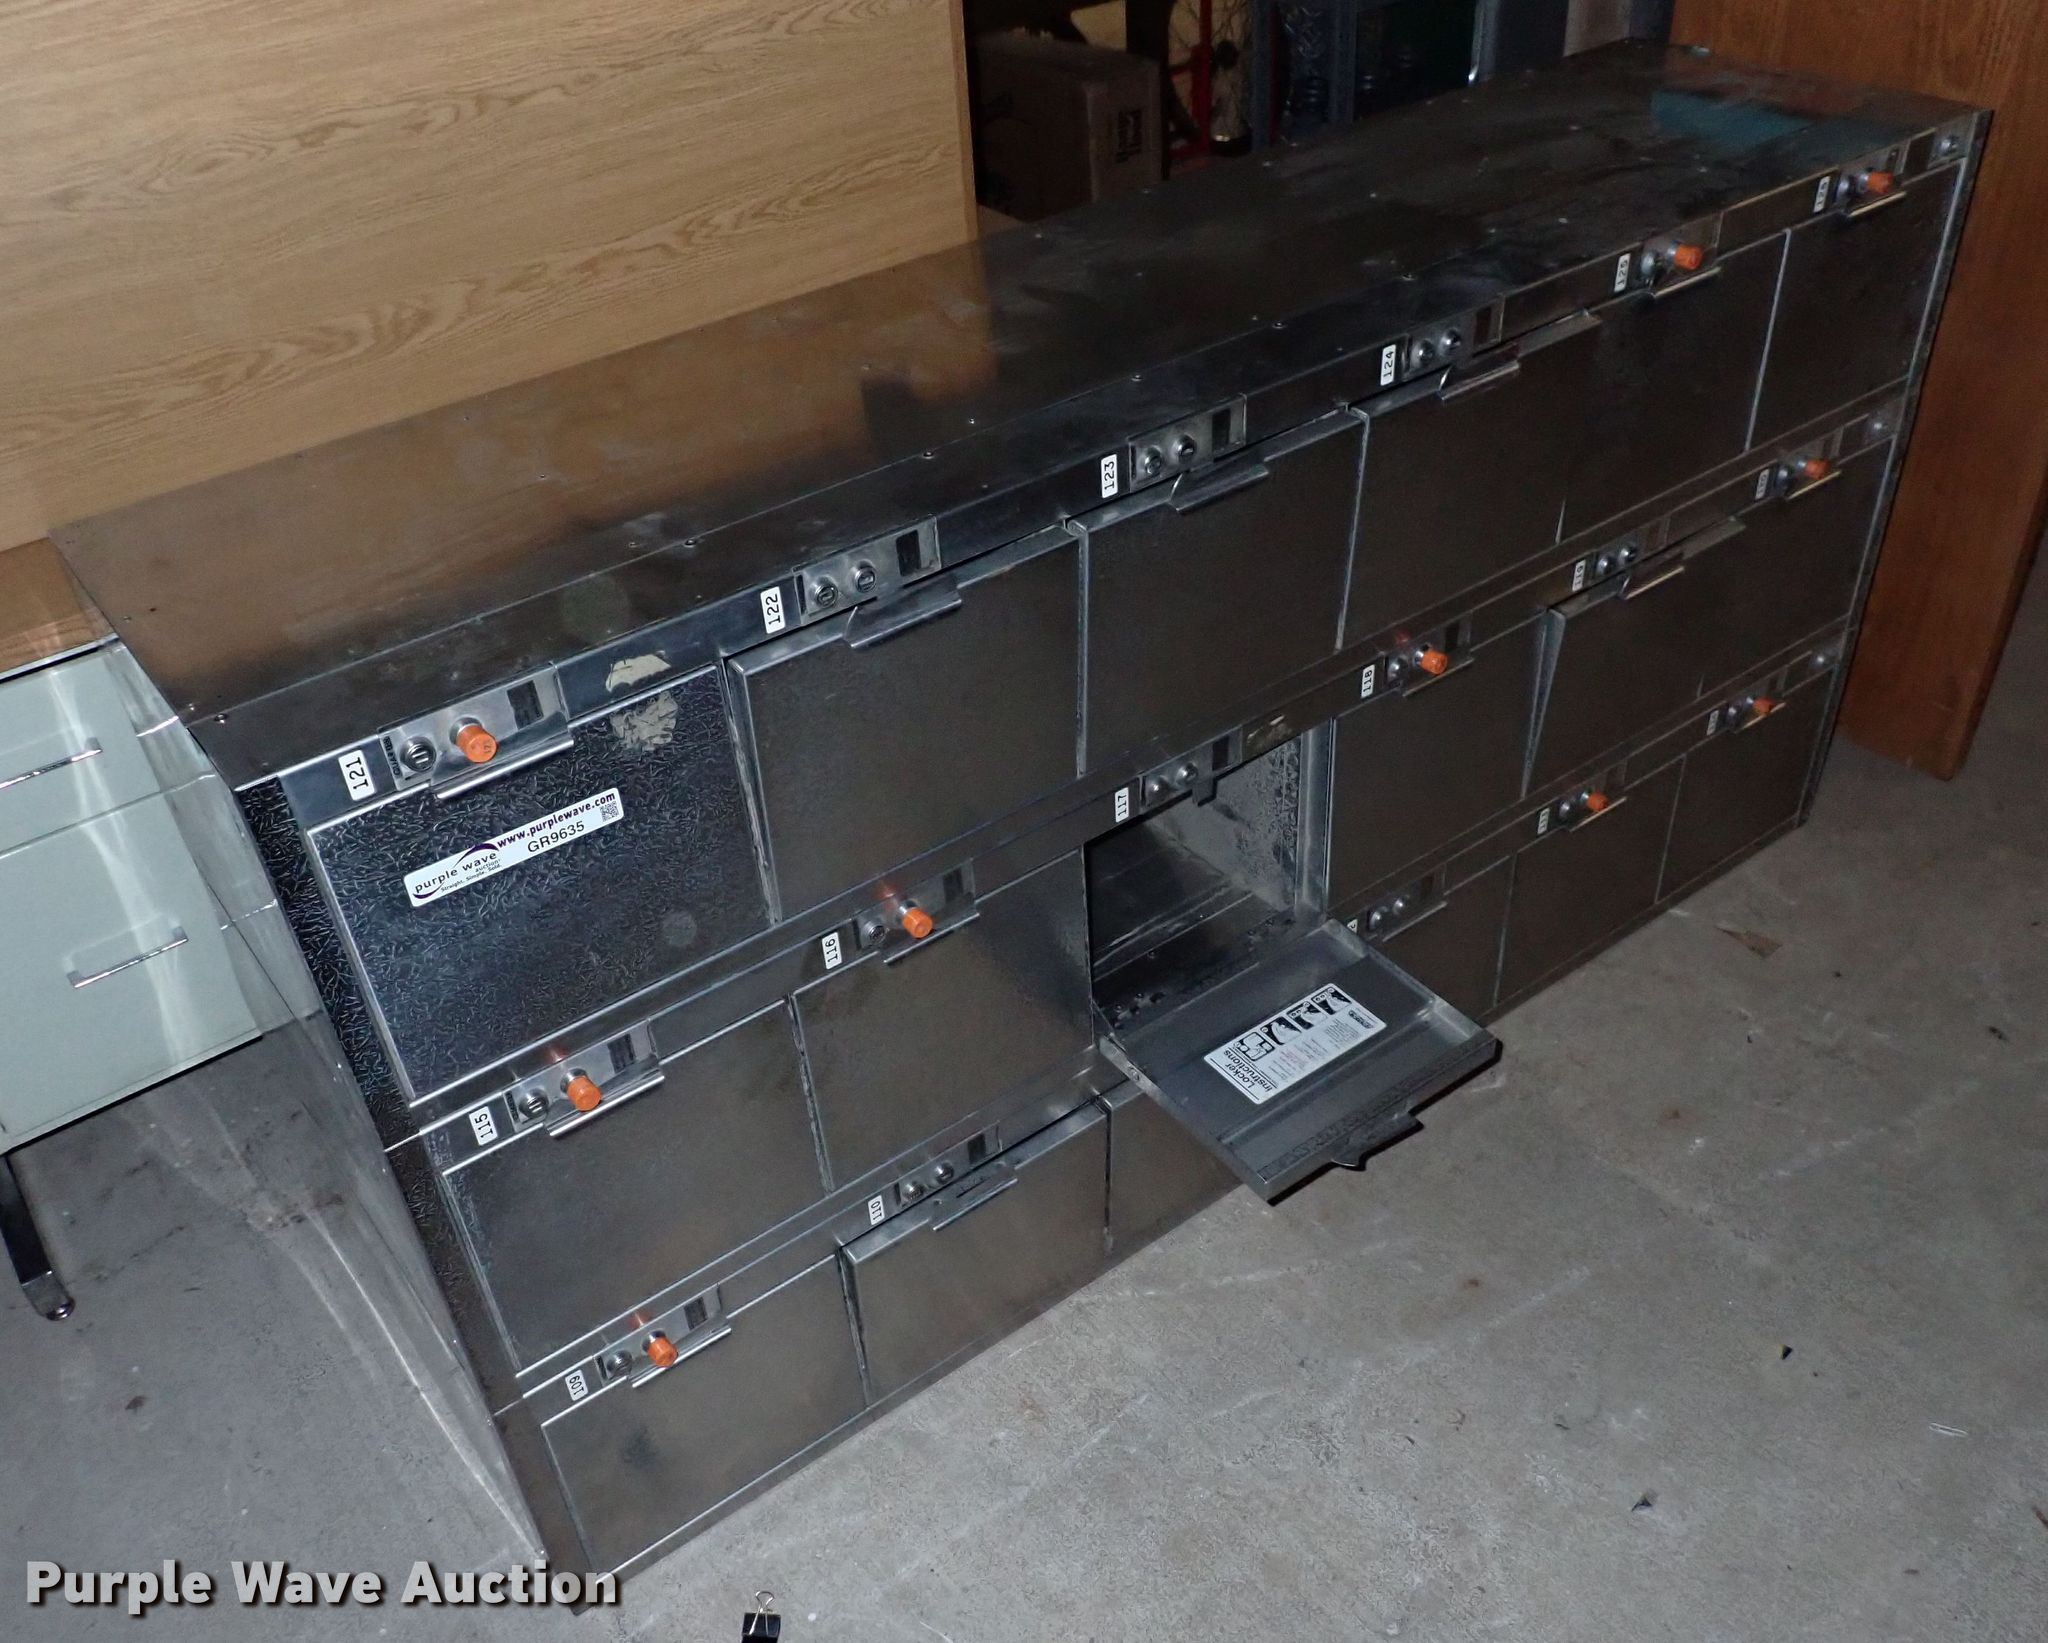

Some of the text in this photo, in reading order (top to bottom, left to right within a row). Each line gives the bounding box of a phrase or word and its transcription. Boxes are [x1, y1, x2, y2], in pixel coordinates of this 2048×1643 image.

[1383, 350, 1394, 378] 124
[1103, 460, 1115, 491] 123
[765, 593, 782, 625] 122
[1362, 669, 1373, 693] 118
[345, 756, 369, 791] 121
[1117, 792, 1127, 817] 117
[497, 792, 616, 848] www.purplewave.com
[527, 820, 586, 853] GR9635
[414, 852, 497, 894] purple wave
[825, 938, 839, 963] 116
[1223, 1049, 1273, 1093] Instructions
[1224, 1062, 1257, 1089] Locker
[474, 1112, 494, 1139] 115
[870, 1200, 882, 1221] 110
[569, 1375, 585, 1396] 109
